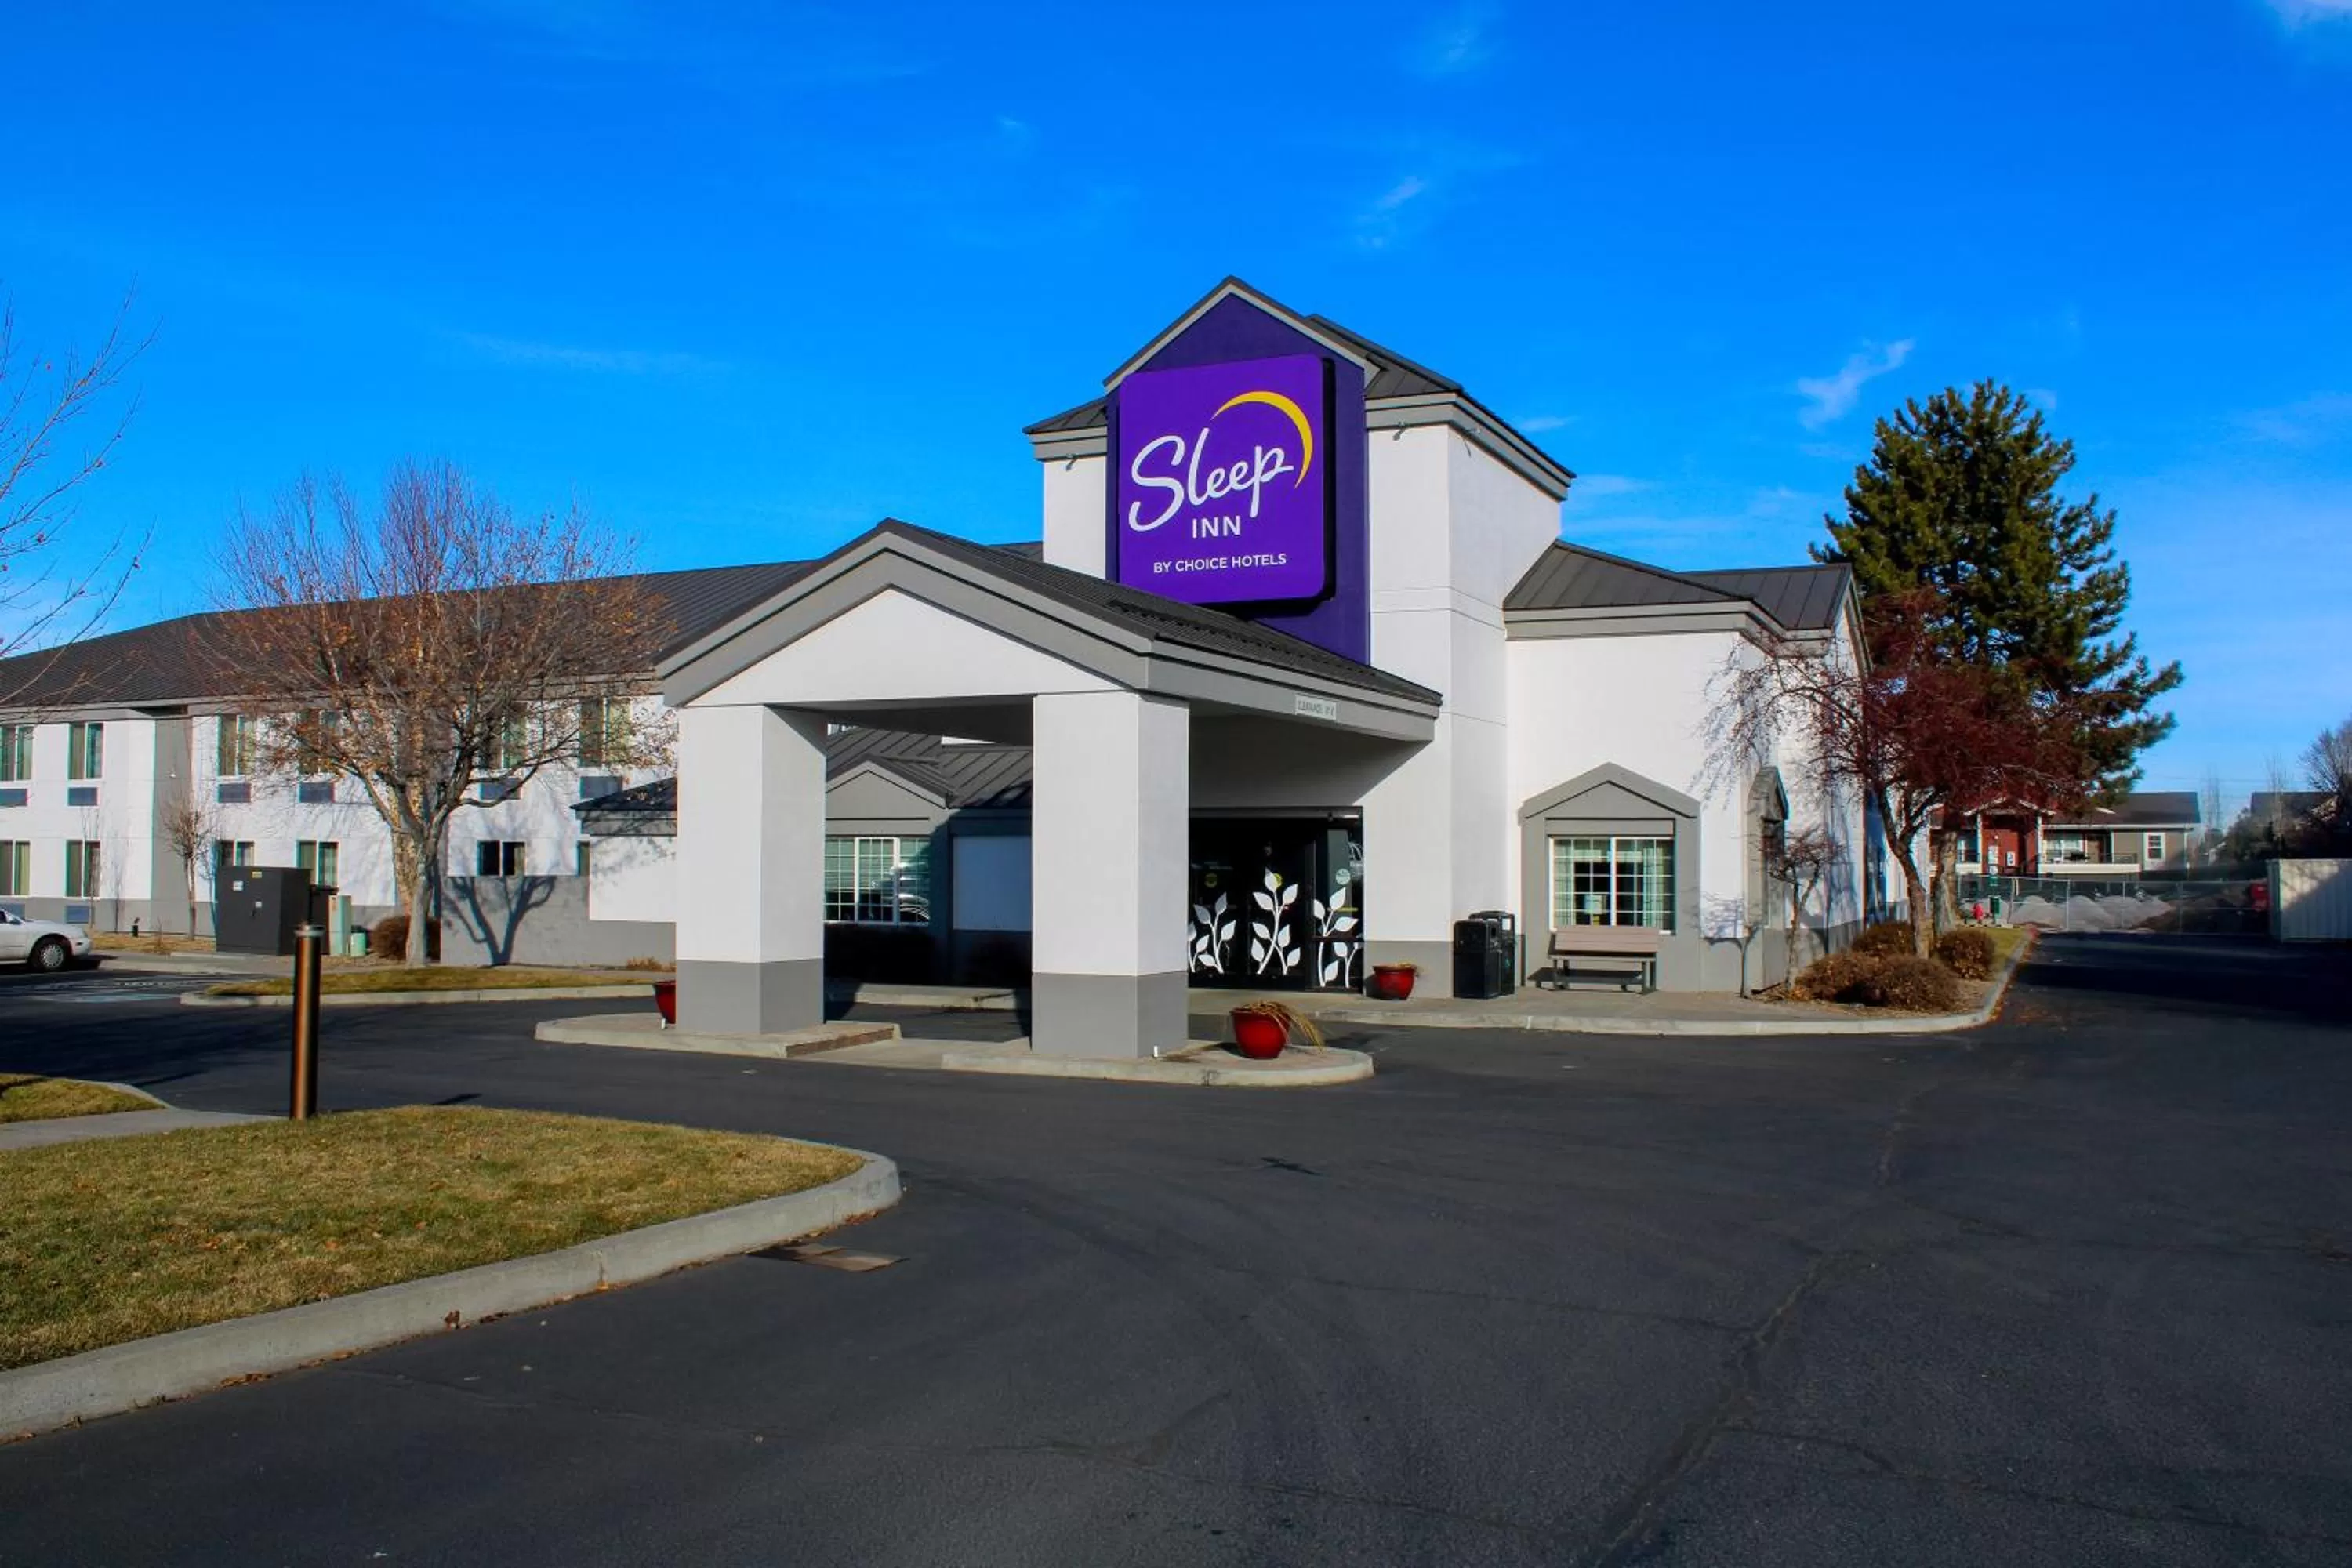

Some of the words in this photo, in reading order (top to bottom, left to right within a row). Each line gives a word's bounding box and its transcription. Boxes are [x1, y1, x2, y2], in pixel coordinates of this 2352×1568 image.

[1128, 427, 1294, 532] Sleep
[1192, 515, 1241, 539] INN
[1153, 561, 1171, 573] BY
[1175, 557, 1227, 572] CHOICE
[1232, 553, 1287, 568] HOTELS
